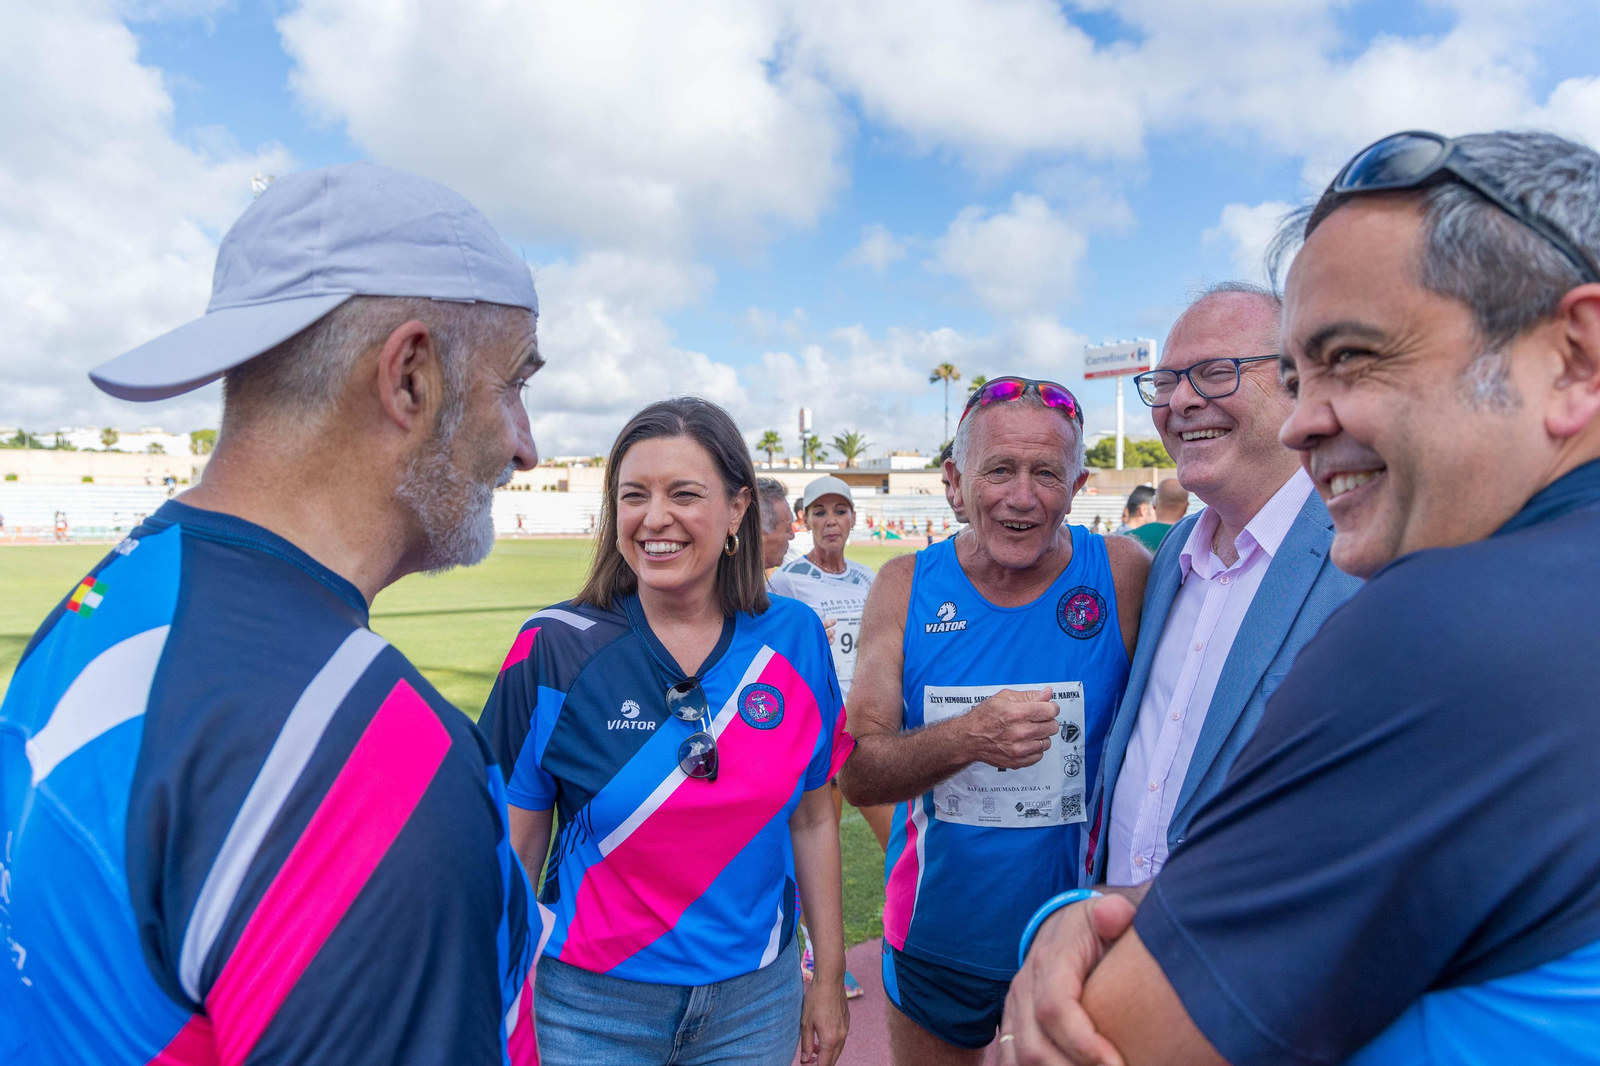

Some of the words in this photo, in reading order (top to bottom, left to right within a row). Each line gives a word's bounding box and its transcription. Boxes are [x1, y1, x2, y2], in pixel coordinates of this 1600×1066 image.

[1085, 352, 1128, 365] Carrefour
[925, 620, 967, 634] VIATOR
[944, 696, 973, 704] MEMORIAL
[1058, 691, 1080, 700] MARINA
[607, 720, 656, 731] VIATOR
[1024, 799, 1052, 808] RECOSUR
